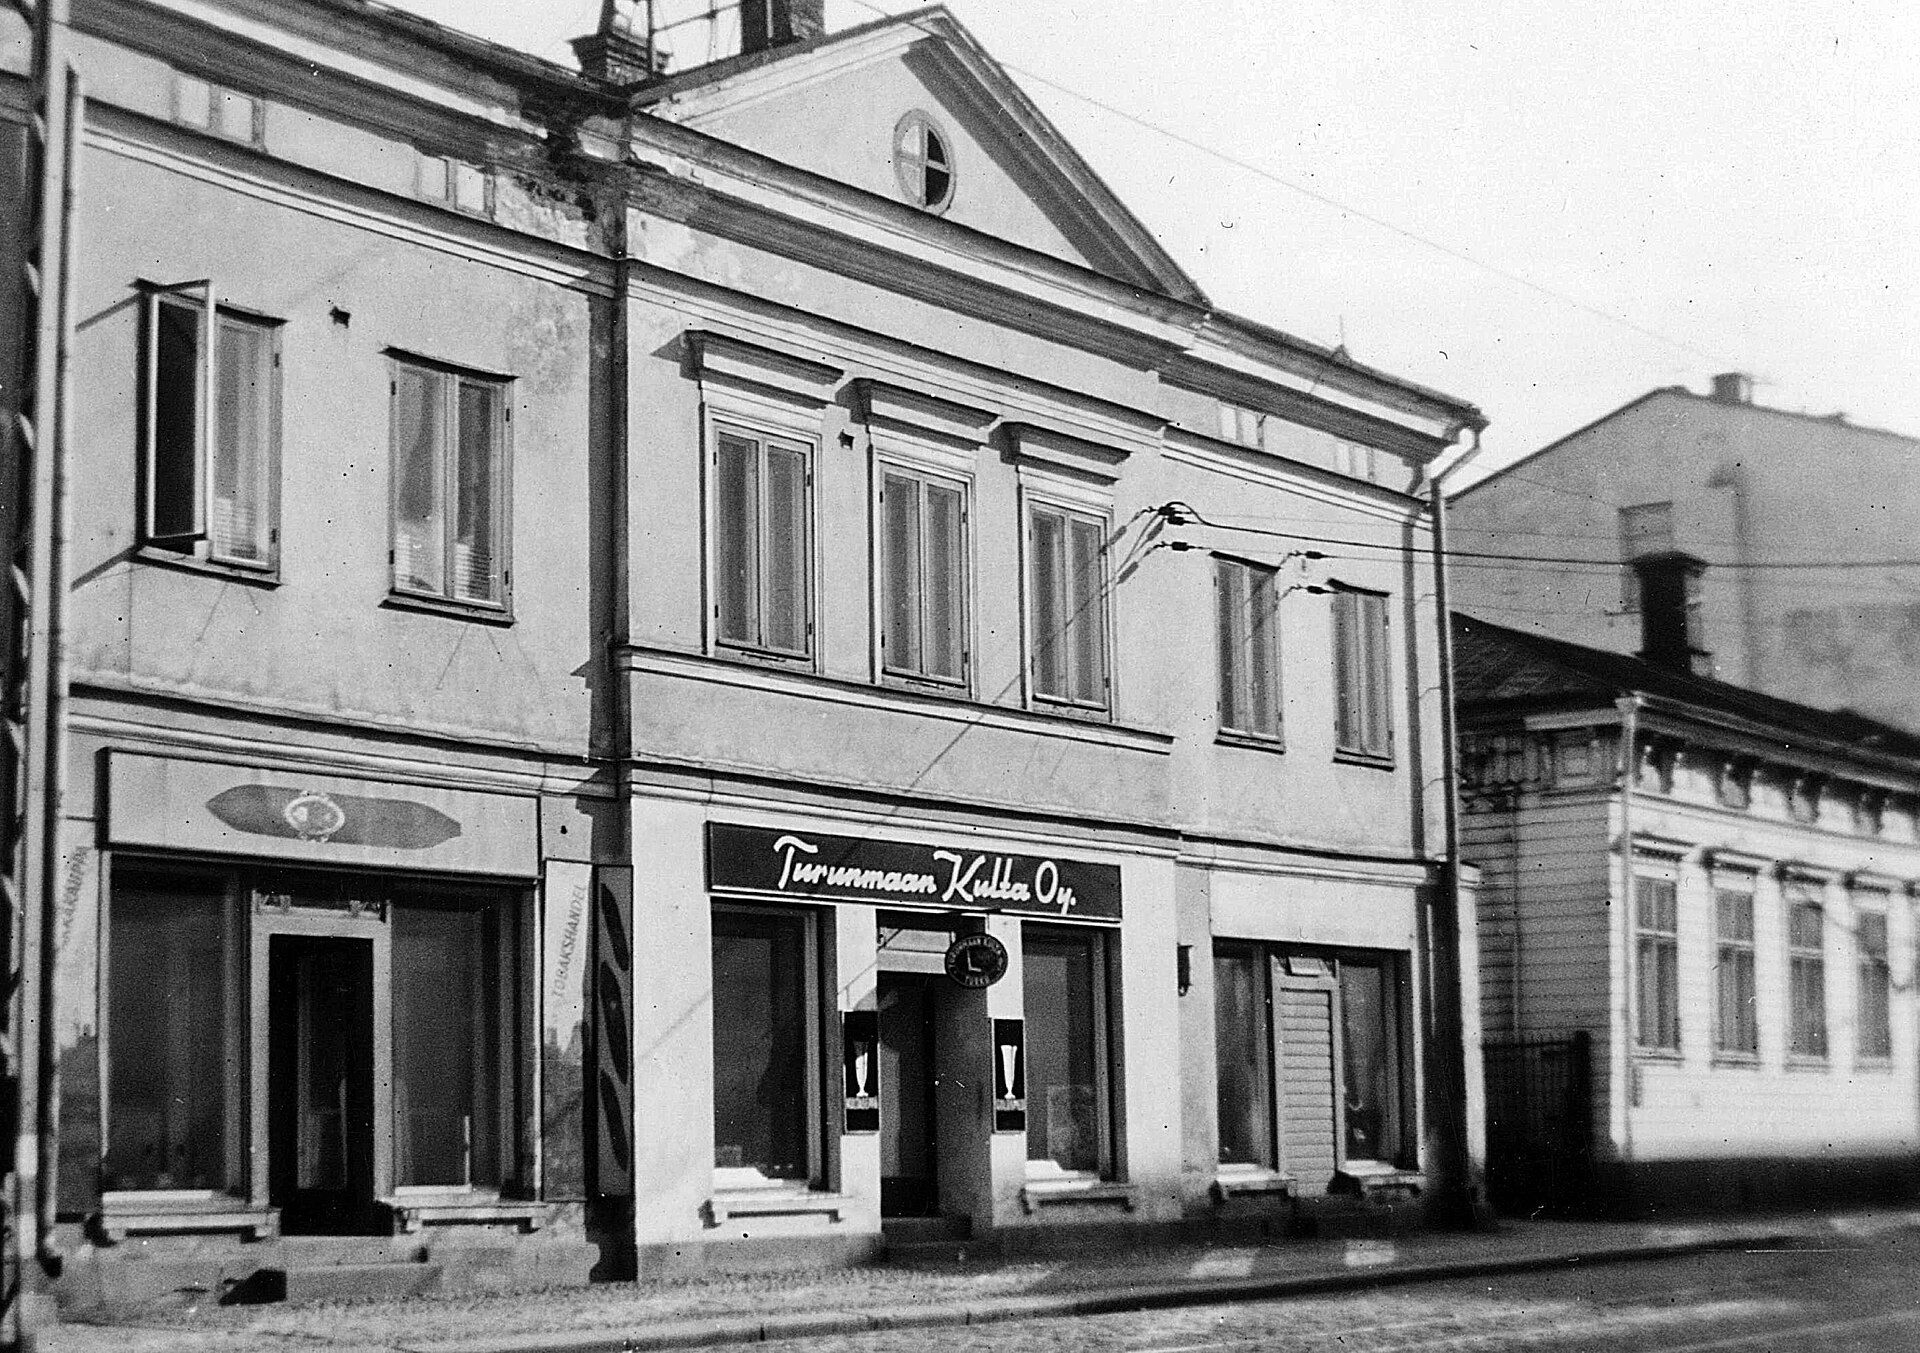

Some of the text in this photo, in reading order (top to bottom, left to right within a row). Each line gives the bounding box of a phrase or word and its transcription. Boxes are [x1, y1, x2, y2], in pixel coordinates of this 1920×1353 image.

[773, 835, 1077, 914] Turunmaan Kulta Oy.
[552, 884, 586, 998] TOBAKSHANDEL
